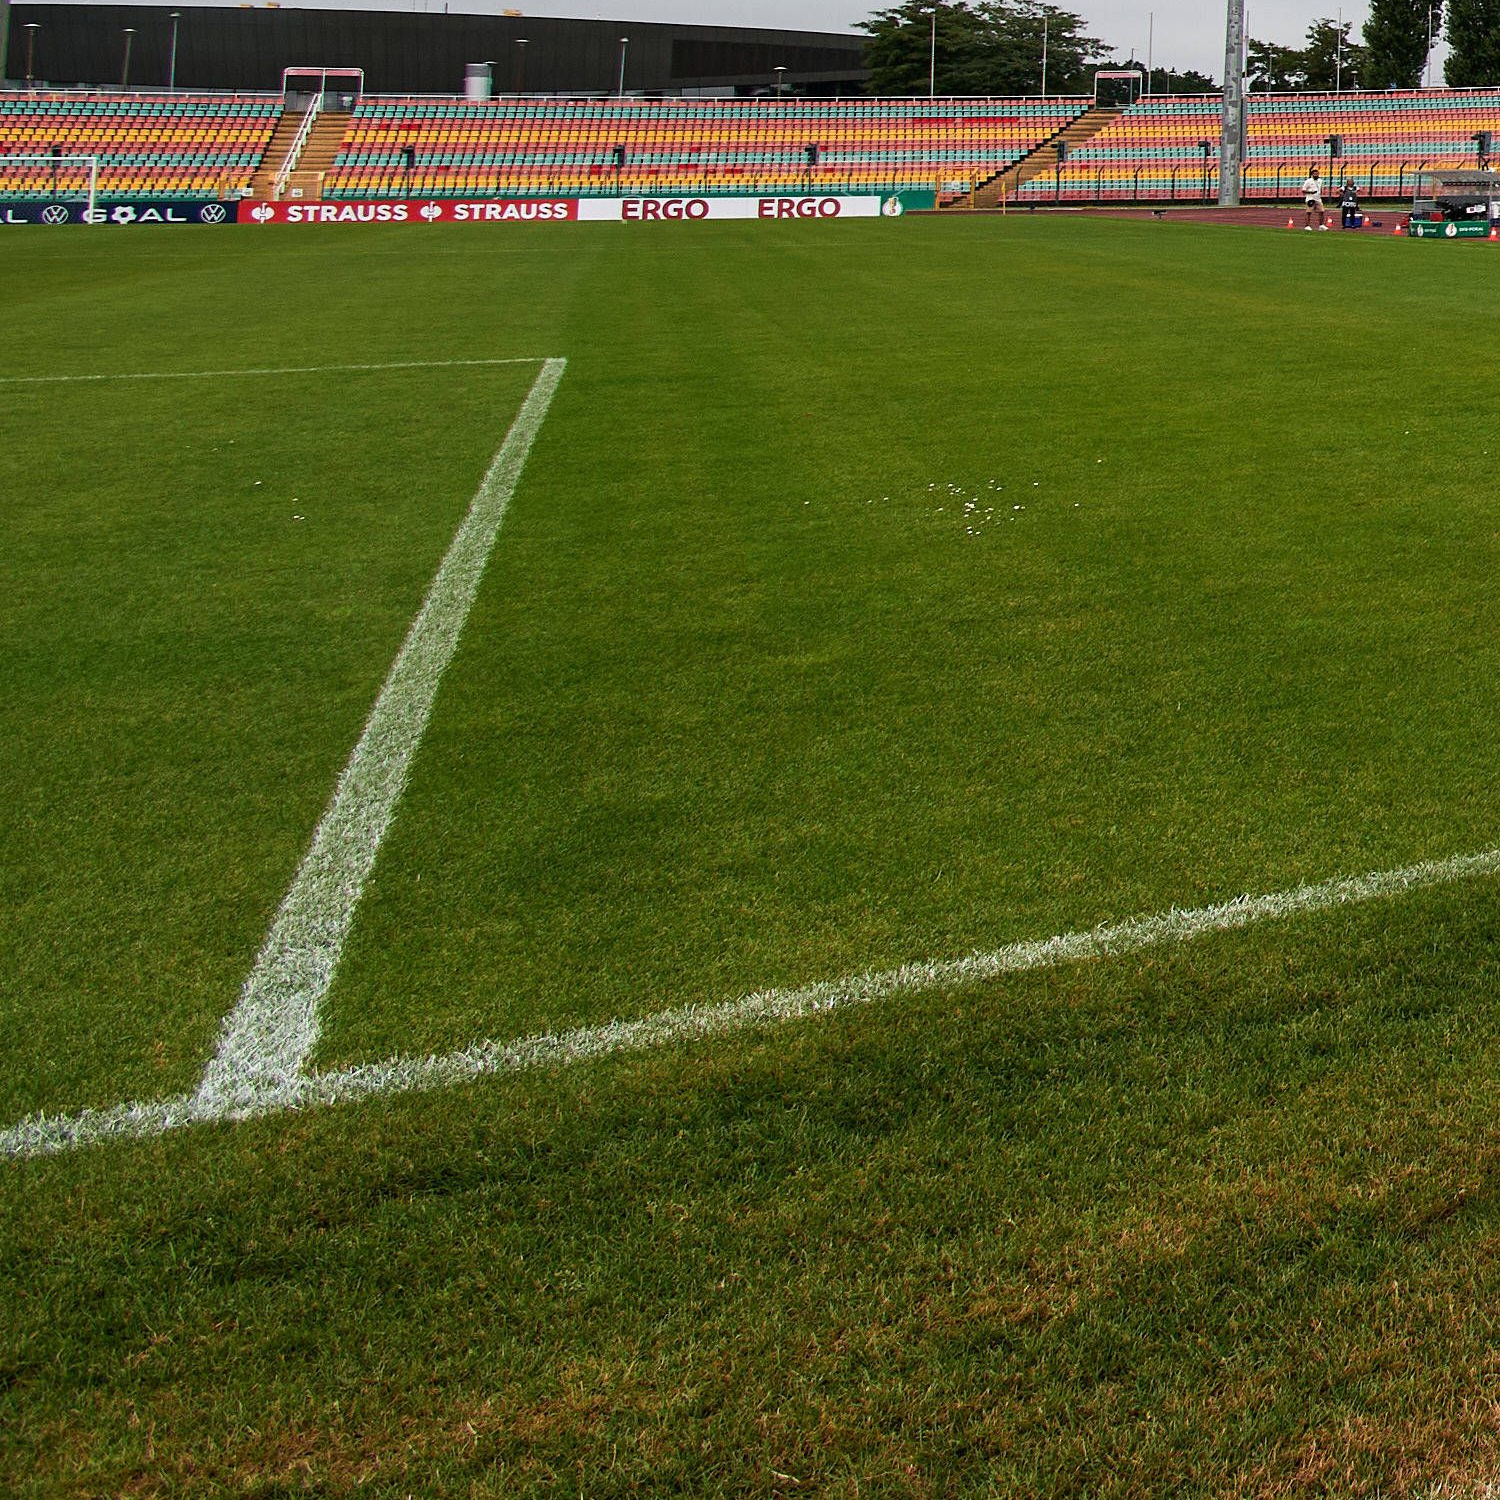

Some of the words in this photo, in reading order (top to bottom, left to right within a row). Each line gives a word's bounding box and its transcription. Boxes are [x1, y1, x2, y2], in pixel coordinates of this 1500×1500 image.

[286, 204, 409, 222] STRAUSS
[454, 202, 568, 220] STRAUSS
[621, 199, 709, 220] ERGO
[758, 197, 841, 219] ERGO
